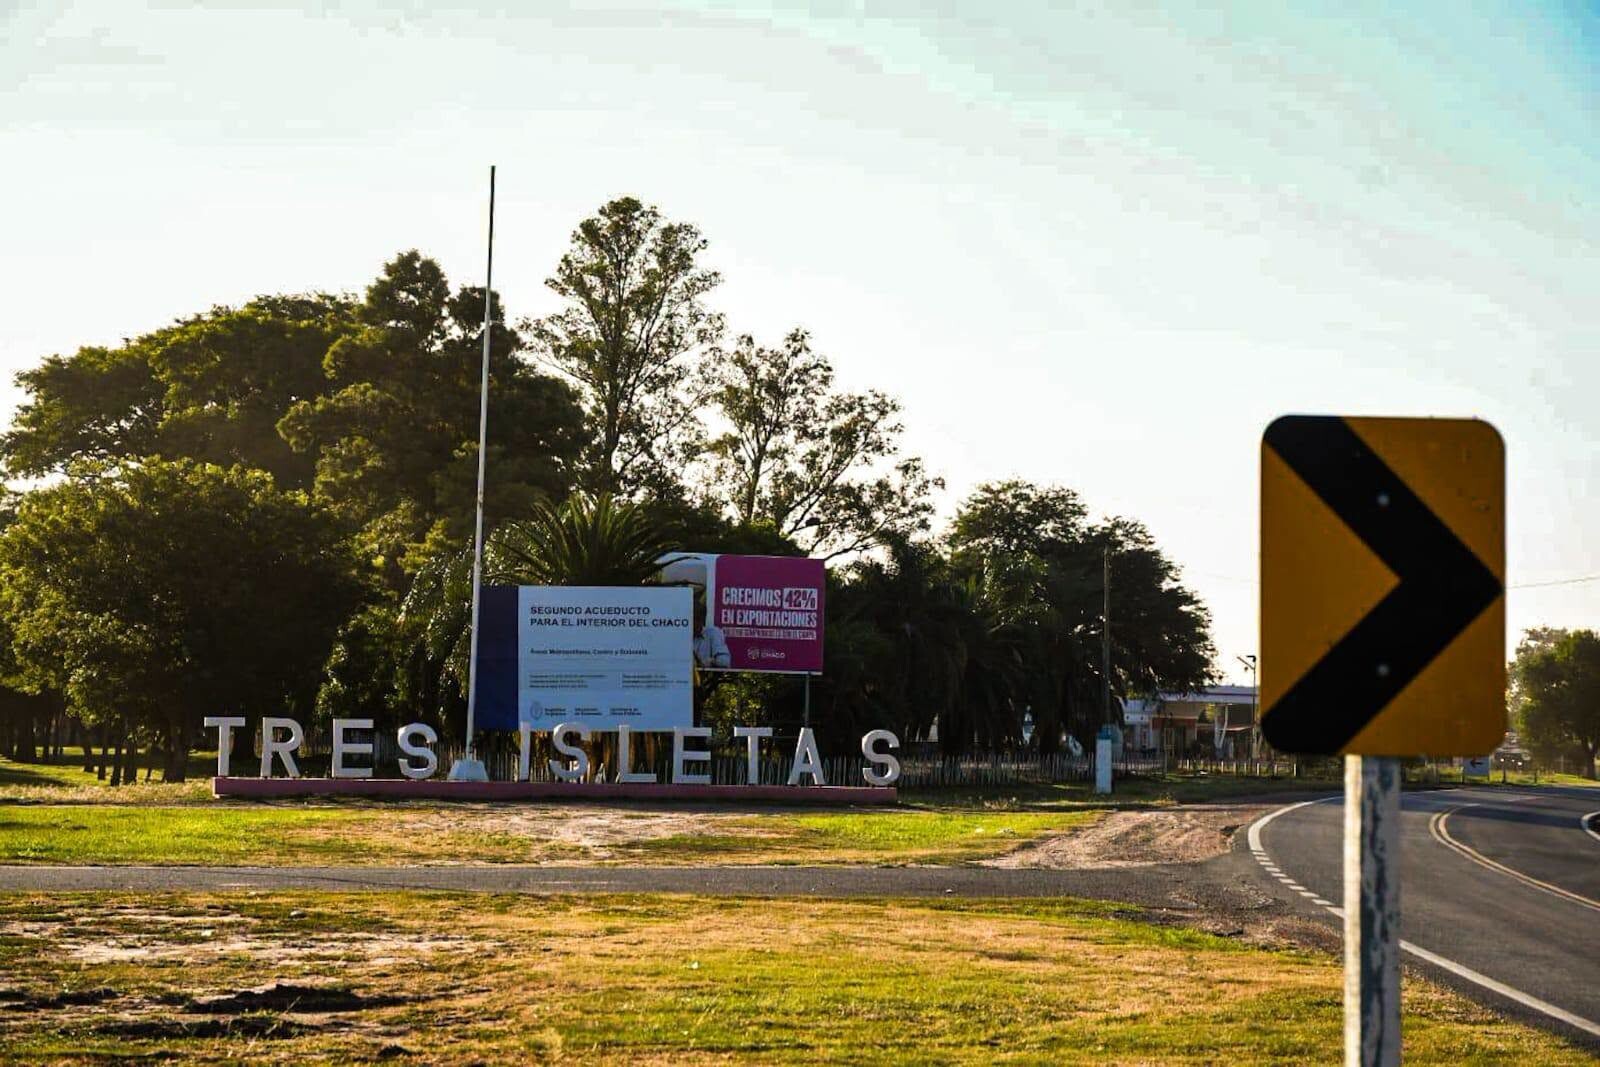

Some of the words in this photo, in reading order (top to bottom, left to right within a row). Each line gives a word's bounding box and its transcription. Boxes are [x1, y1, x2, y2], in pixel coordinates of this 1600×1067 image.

[722, 587, 781, 607] CRECIMOS
[784, 589, 816, 609] 42%
[530, 606, 582, 615] SEGUNDO
[585, 606, 650, 615] ACUEDUCTO
[721, 609, 735, 624] EN
[736, 610, 817, 627] EXPORTACIONES
[530, 618, 558, 627] PARA
[561, 618, 573, 627] EL
[577, 618, 626, 627] INTERIOR
[629, 619, 648, 627] DEL
[651, 619, 689, 628] CHACO
[203, 716, 438, 780] TRES
[519, 721, 900, 787] ISLETAS
